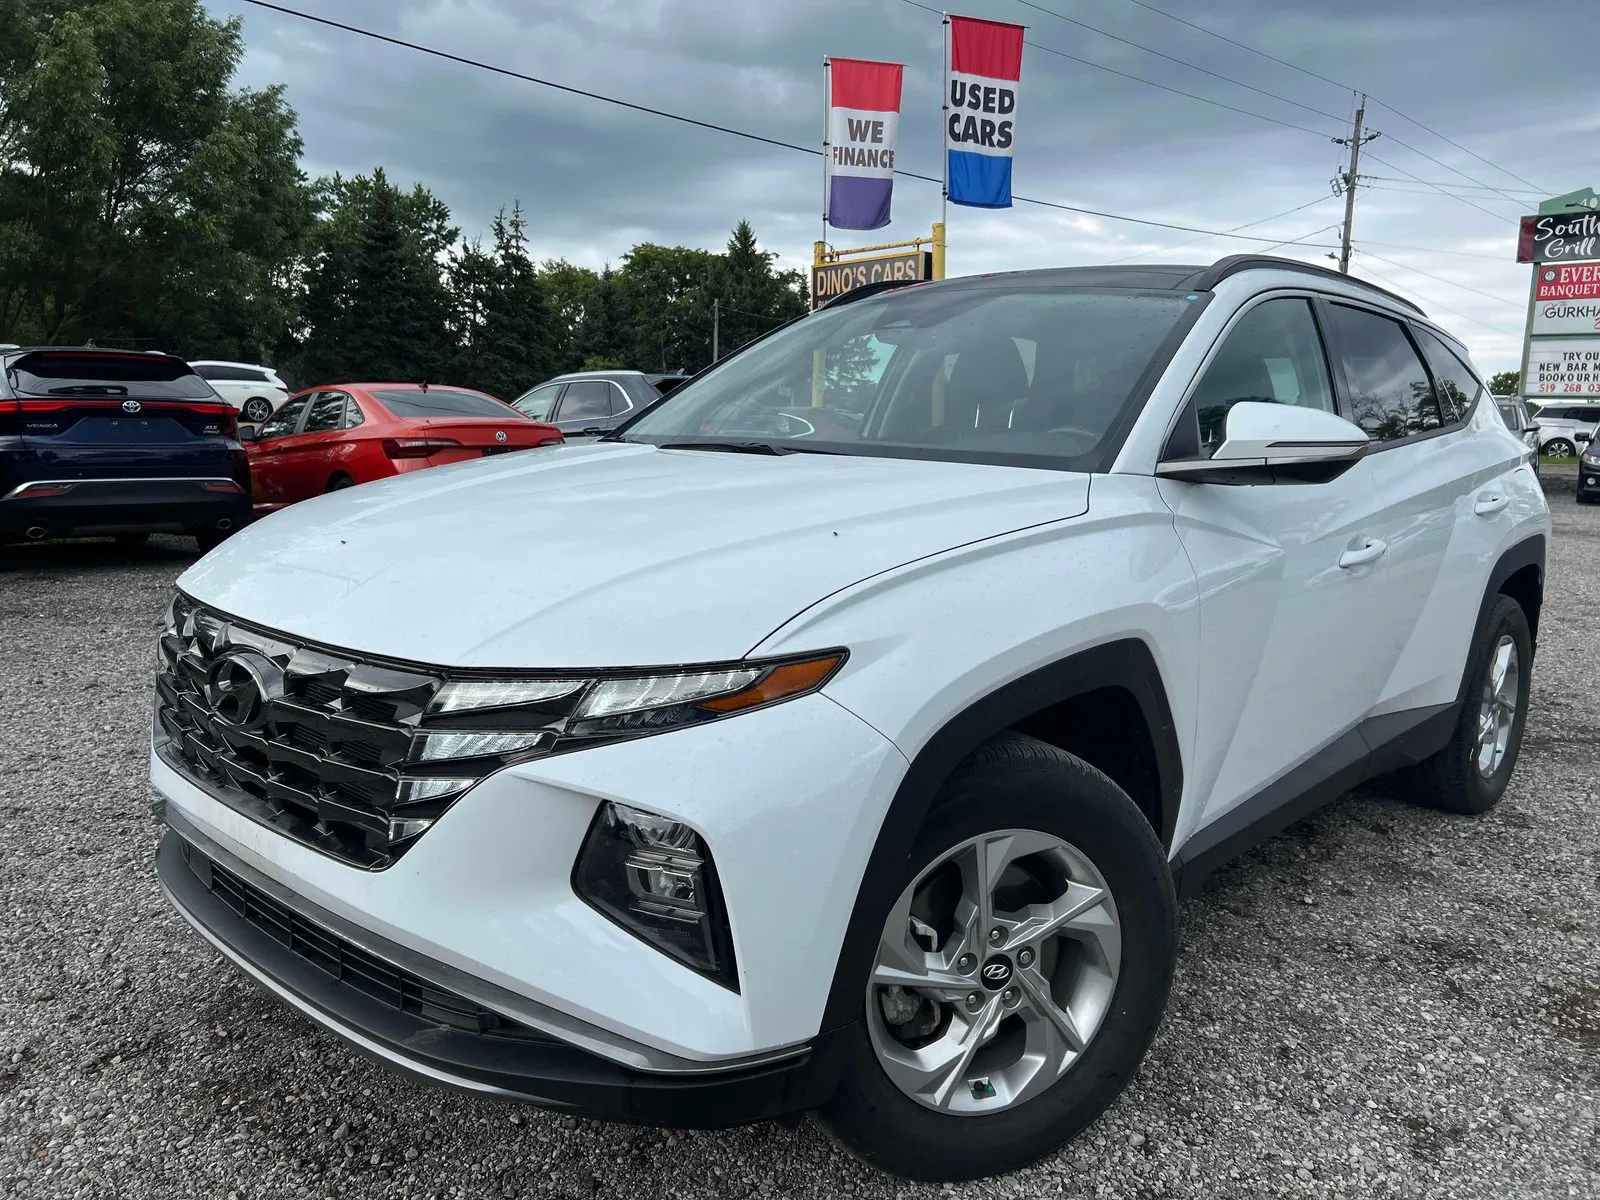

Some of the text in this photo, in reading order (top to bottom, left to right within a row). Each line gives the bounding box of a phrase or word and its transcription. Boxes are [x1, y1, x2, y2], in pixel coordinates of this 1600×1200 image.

[951, 79, 1015, 115] USED
[847, 118, 884, 144] WE
[948, 113, 1013, 149] CARS
[832, 146, 895, 169] FINANCE
[1544, 237, 1596, 258] Grill
[816, 259, 916, 297] DINO'S CARS
[1539, 283, 1600, 298] BANQUET
[1539, 362, 1561, 371] NEW
[1567, 362, 1588, 371] BAR
[1562, 352, 1582, 361] TRY
[1539, 383, 1556, 392] 519
[1563, 383, 1582, 392] 268
